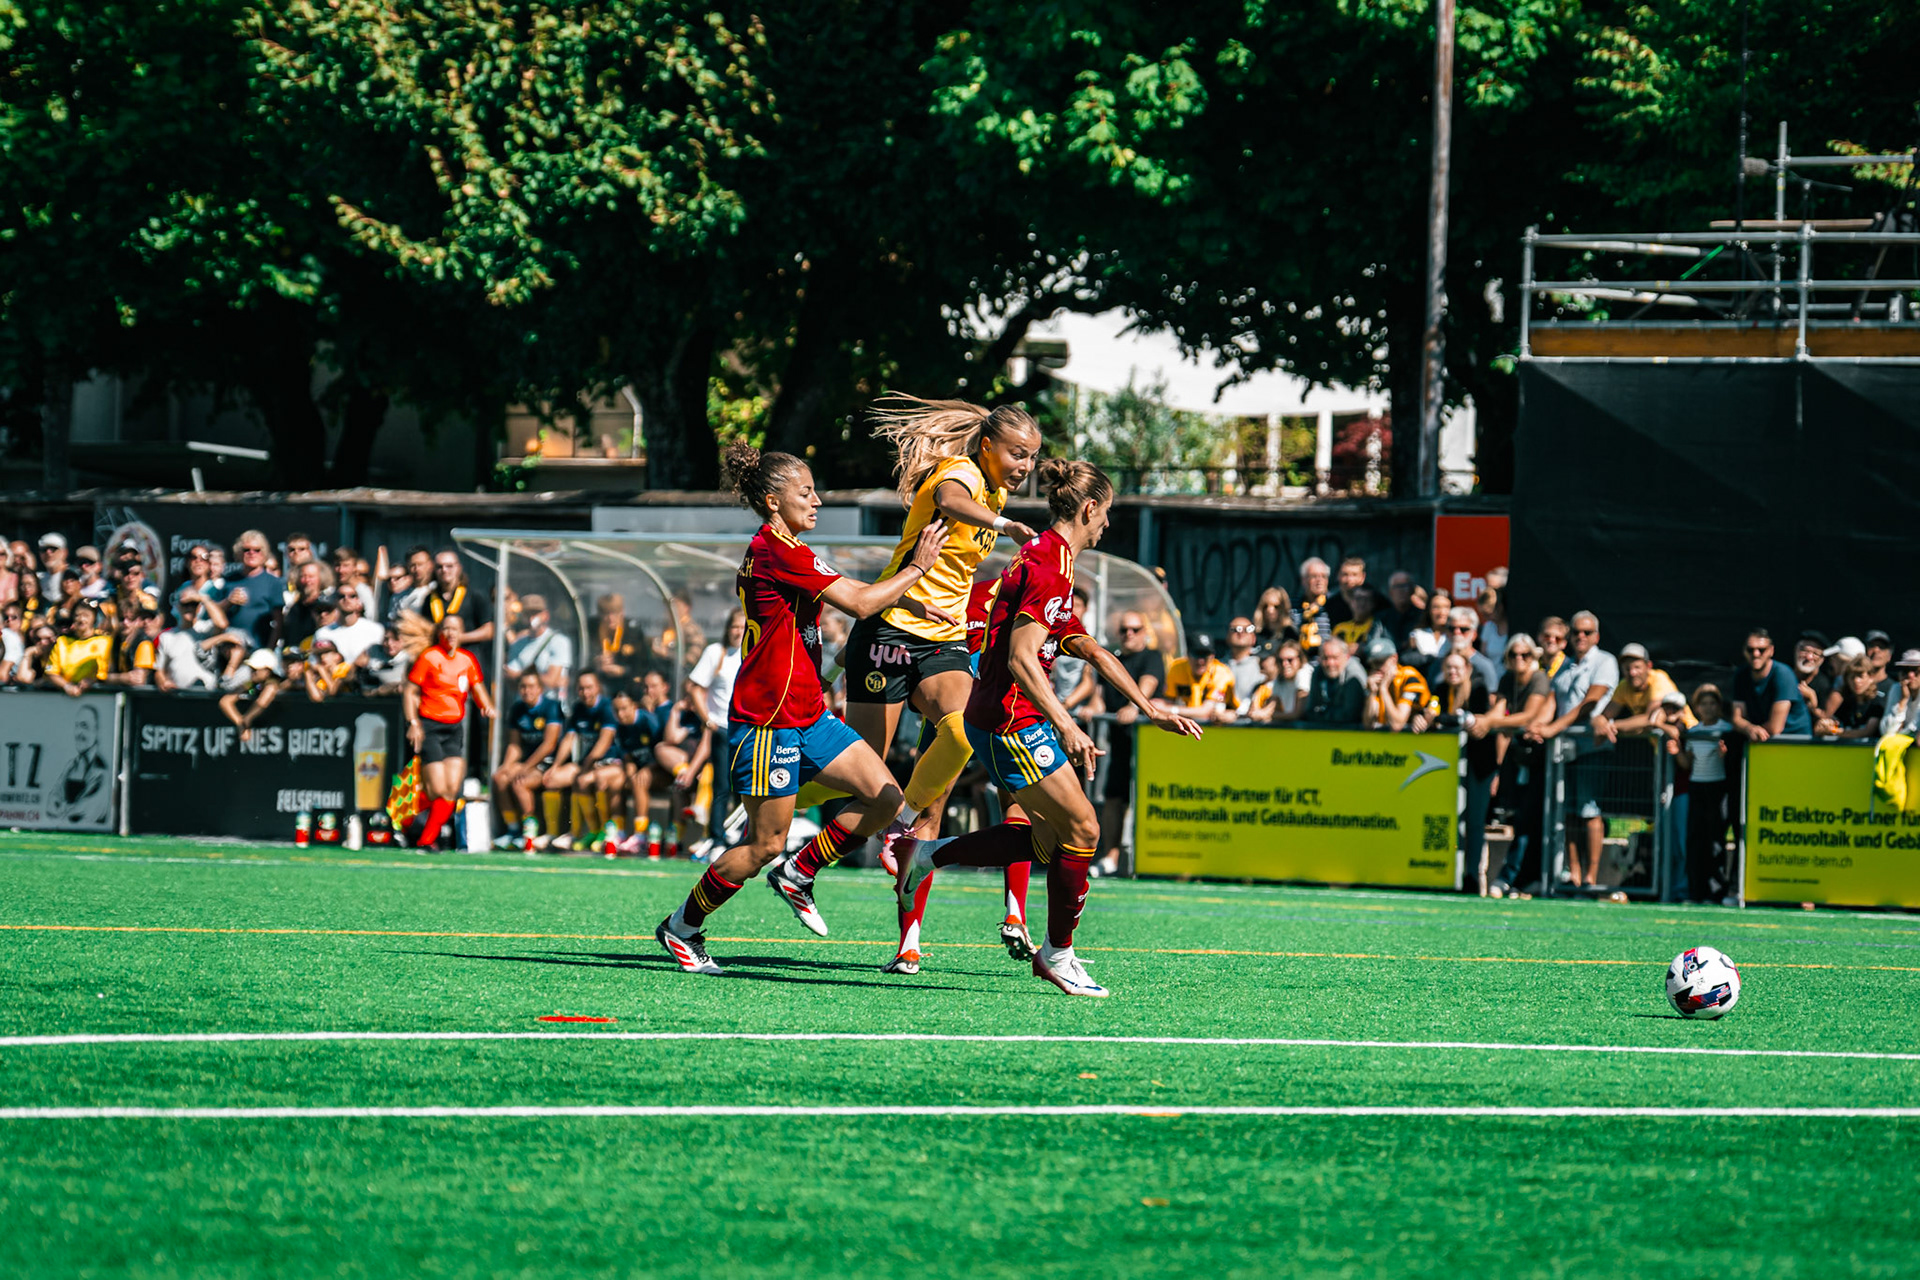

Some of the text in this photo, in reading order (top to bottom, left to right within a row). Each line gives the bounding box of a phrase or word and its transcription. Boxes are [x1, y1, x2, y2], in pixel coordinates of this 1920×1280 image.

[869, 643, 911, 668] yuh
[141, 724, 198, 758] SPITZ
[203, 726, 236, 756] UF
[287, 727, 349, 758] BIER?
[1331, 748, 1407, 767] Burkhalter
[1147, 784, 1322, 806] Ihr Elektro-Partner für ICT,
[1147, 804, 1400, 831] Photovoltaik und Gebäudeautomation.
[1759, 806, 1779, 822] Ihr
[1782, 806, 1898, 826] Elektro-Partner
[1759, 828, 1851, 848] Photovoltaik
[1854, 832, 1882, 848] und
